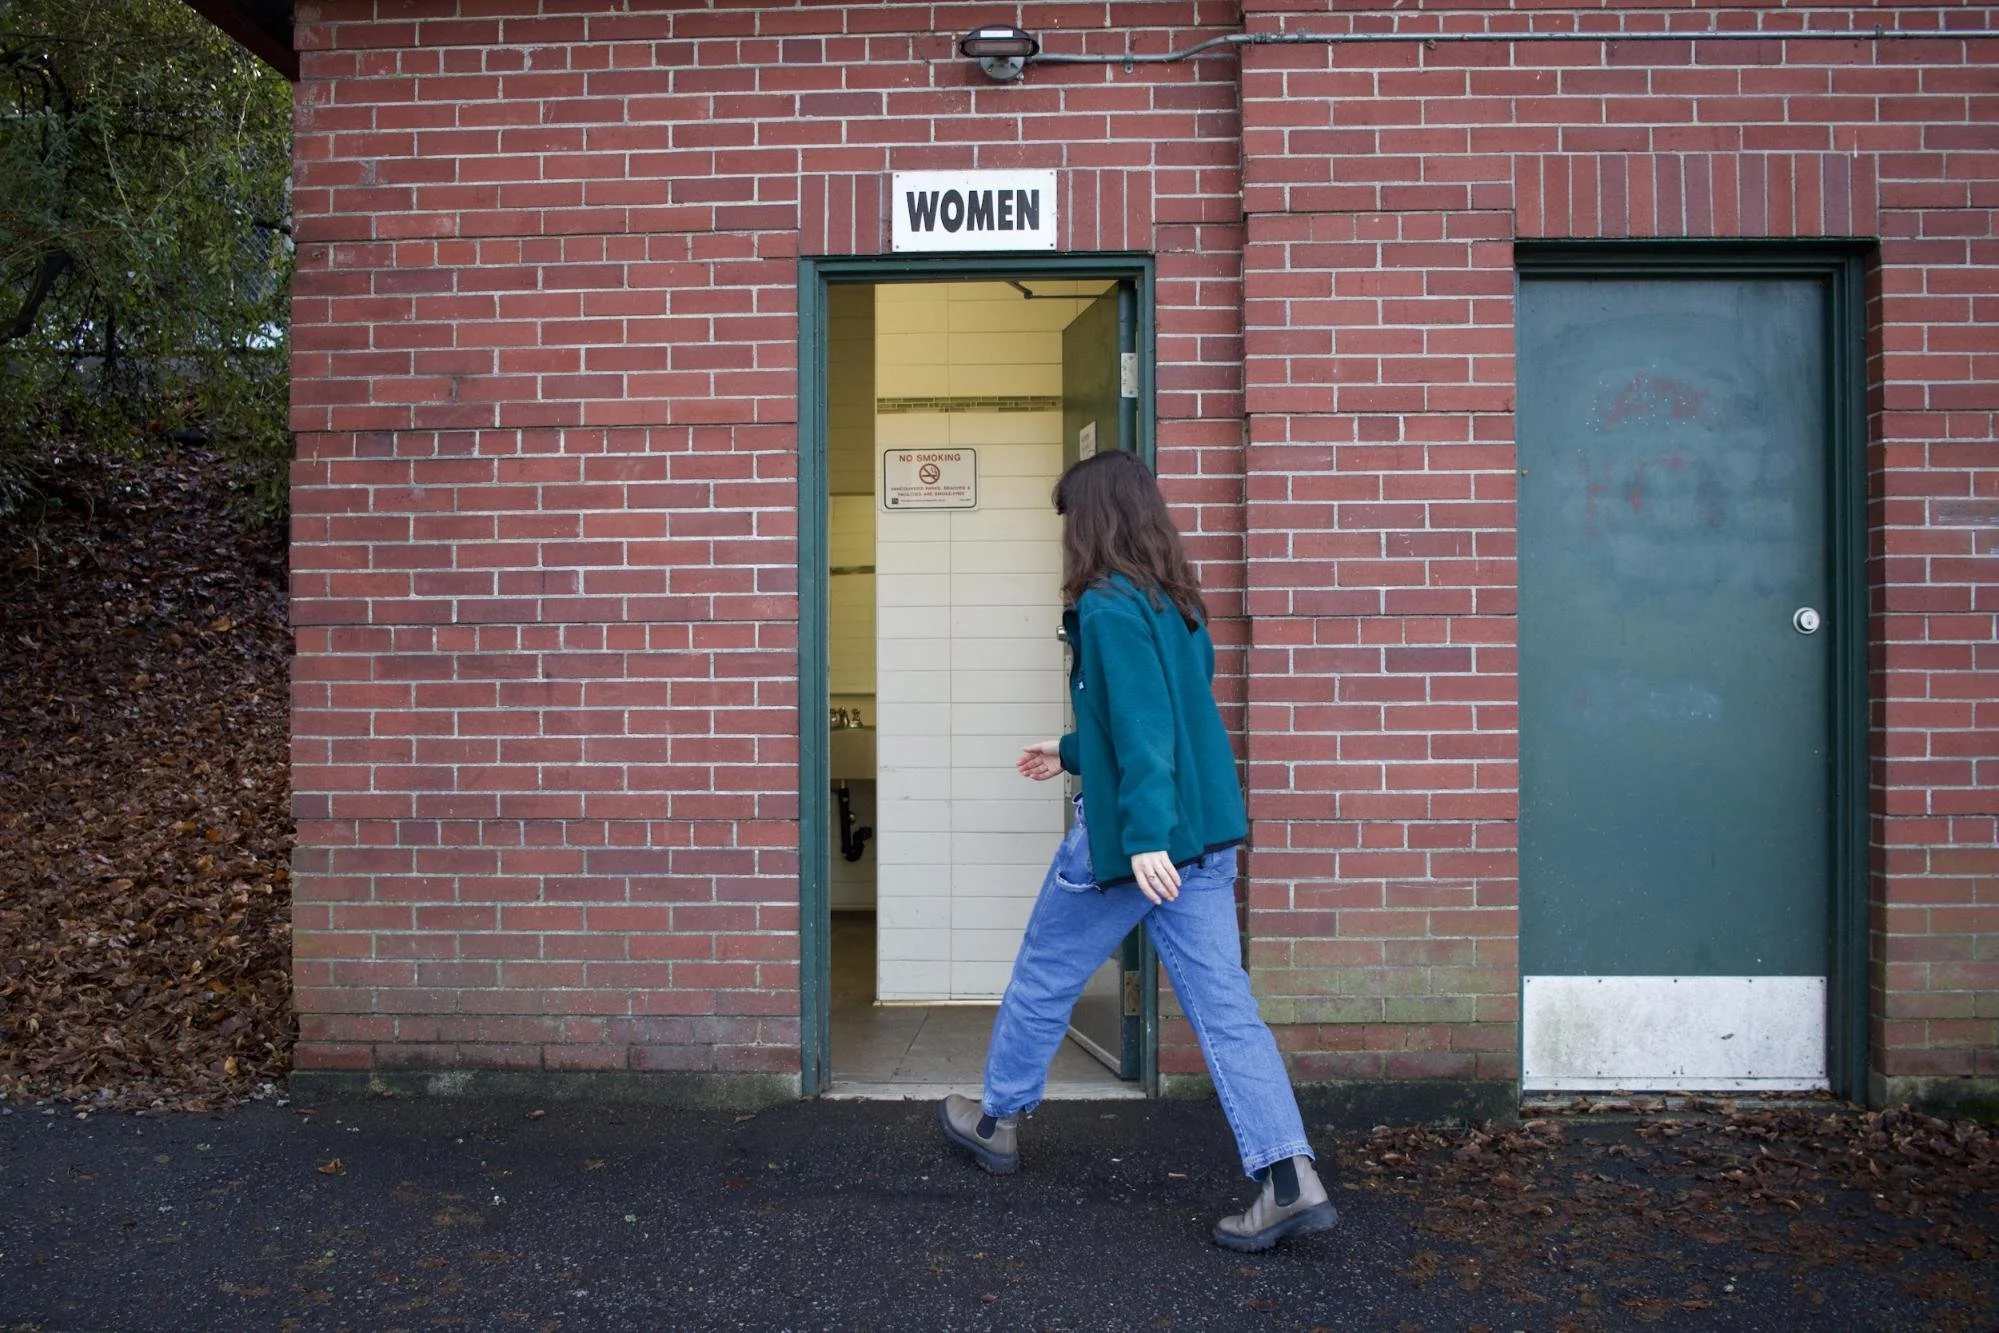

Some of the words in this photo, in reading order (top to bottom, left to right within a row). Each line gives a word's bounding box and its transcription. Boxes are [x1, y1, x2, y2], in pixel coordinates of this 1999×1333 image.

[906, 189, 1040, 233] WOMEN
[899, 454, 913, 462] NO
[916, 453, 961, 462] SMOKING
